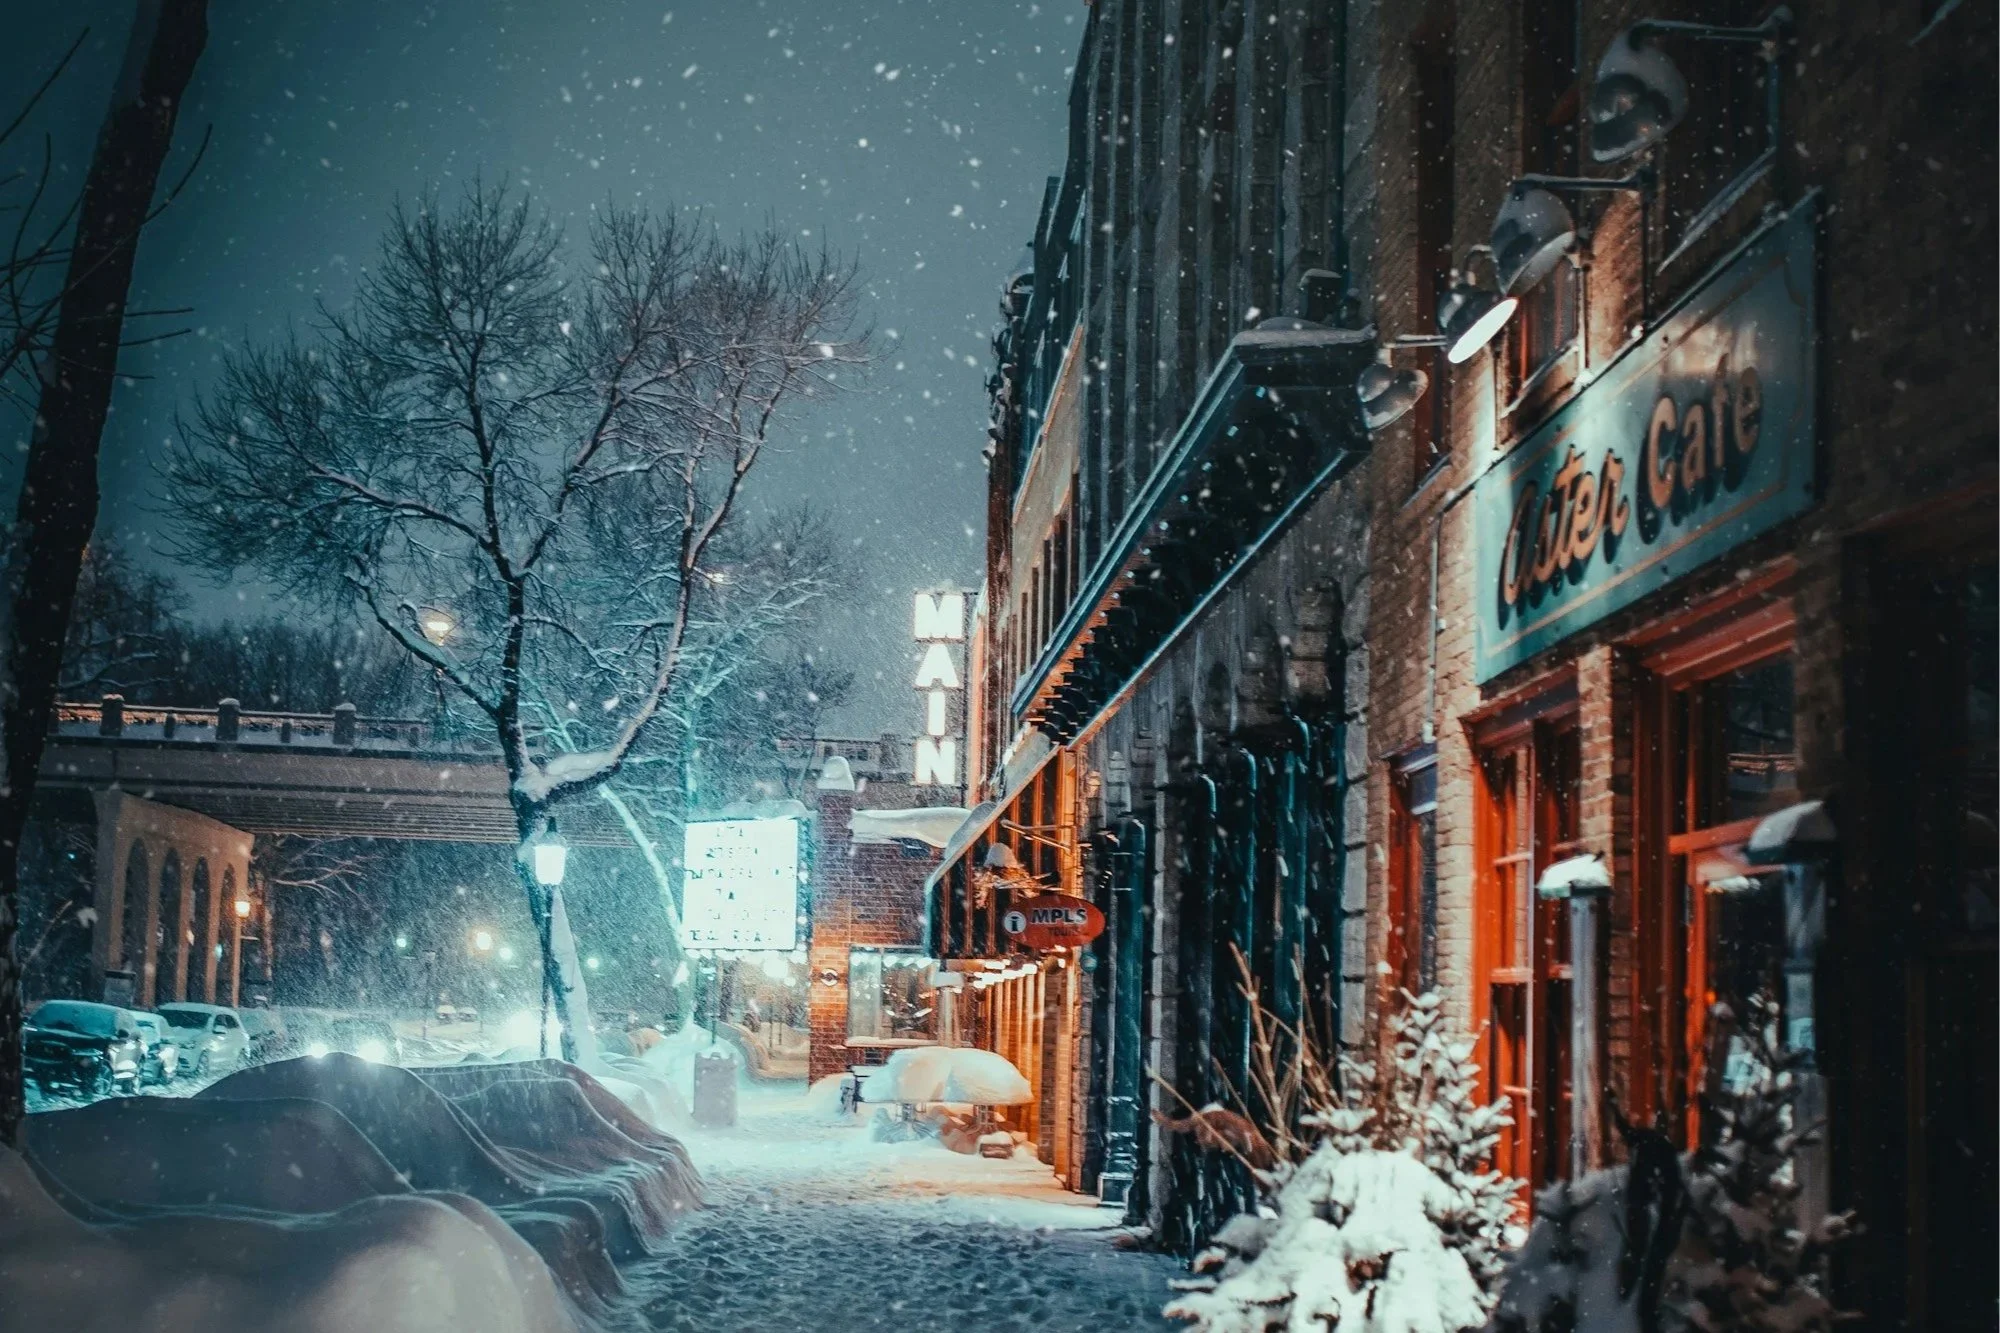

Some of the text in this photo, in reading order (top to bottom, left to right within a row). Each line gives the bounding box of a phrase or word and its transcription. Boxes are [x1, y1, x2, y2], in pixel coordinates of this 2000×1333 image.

[1503, 352, 1763, 610] Aster Cafe
[914, 594, 963, 785] MAIN
[1031, 908, 1087, 924] MPLS
